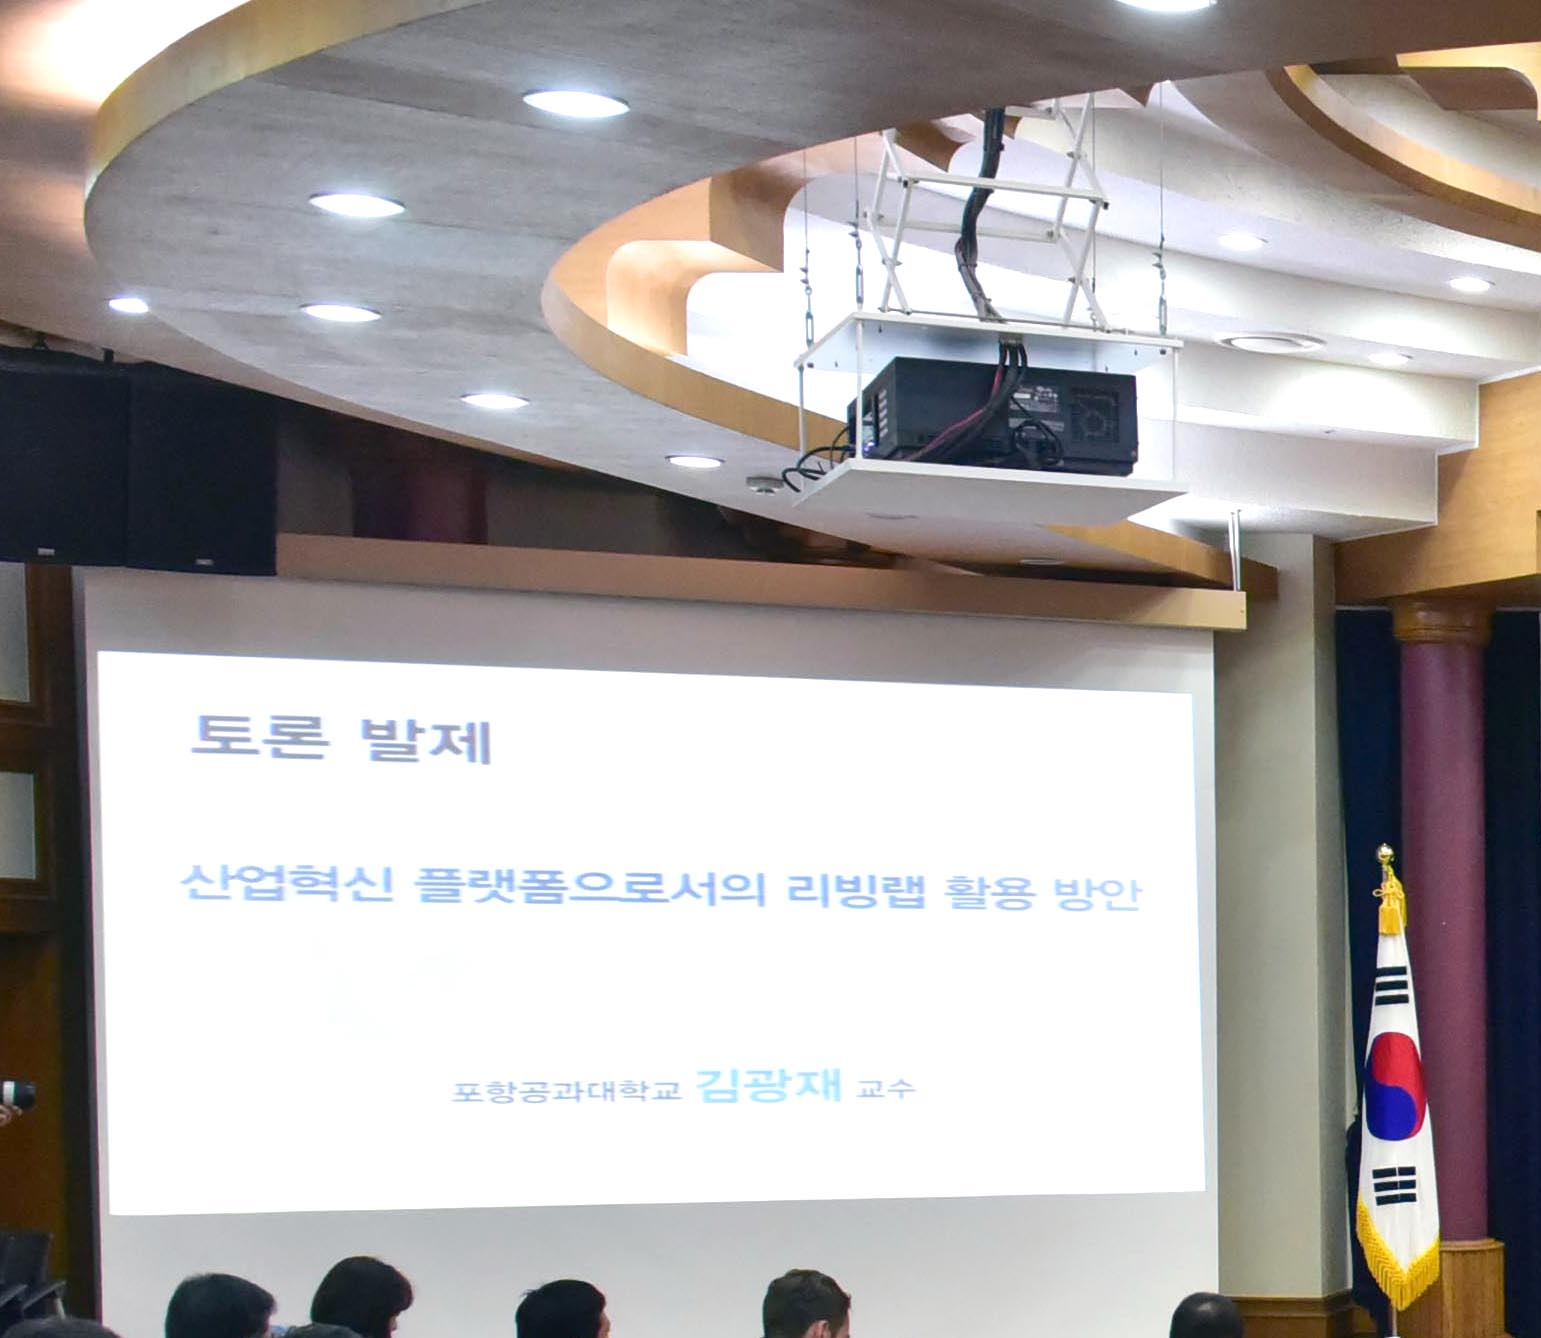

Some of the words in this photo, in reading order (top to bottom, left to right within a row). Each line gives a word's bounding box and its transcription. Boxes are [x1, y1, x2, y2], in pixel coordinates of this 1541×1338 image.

[191, 715, 331, 761] 토론
[361, 718, 492, 765] 발제
[180, 864, 394, 903] 산업혁신
[413, 867, 766, 908] 플랫폼으로서의
[787, 873, 926, 910] 리빙랩
[944, 875, 1038, 911] 활용
[1053, 877, 1144, 913] 방안
[451, 1079, 683, 1105] 포항공과대학교
[695, 1067, 842, 1104] 김광재
[855, 1078, 917, 1100] 교수
